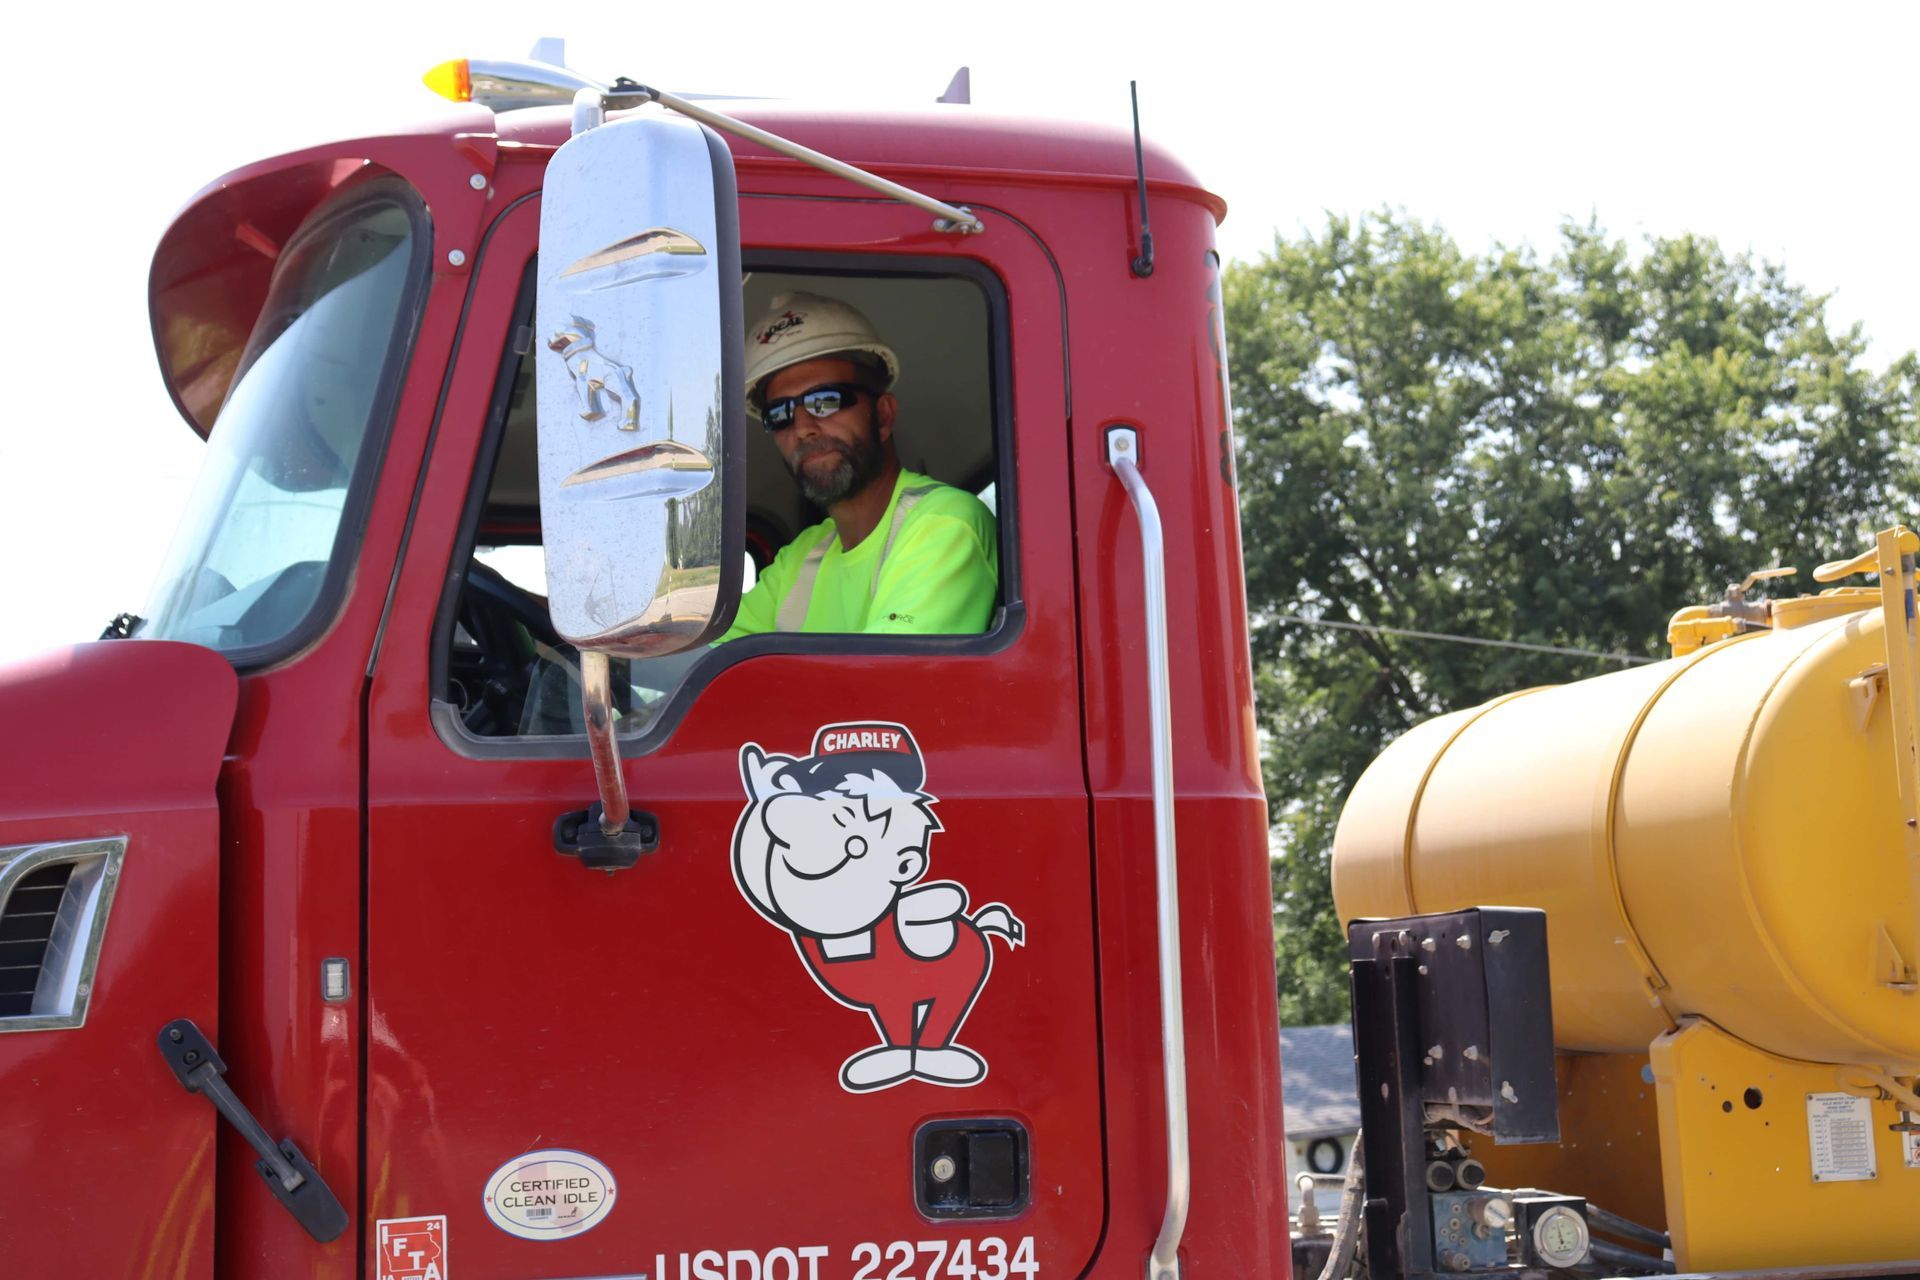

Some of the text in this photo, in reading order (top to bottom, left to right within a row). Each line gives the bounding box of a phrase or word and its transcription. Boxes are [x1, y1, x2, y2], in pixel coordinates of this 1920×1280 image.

[823, 731, 902, 752] CHARLEY
[510, 1177, 590, 1193] CERTIFIED
[503, 1191, 598, 1208] CLEAN IDLE
[426, 1222, 441, 1231] 24
[656, 1236, 1040, 1280] USDOT 227434
